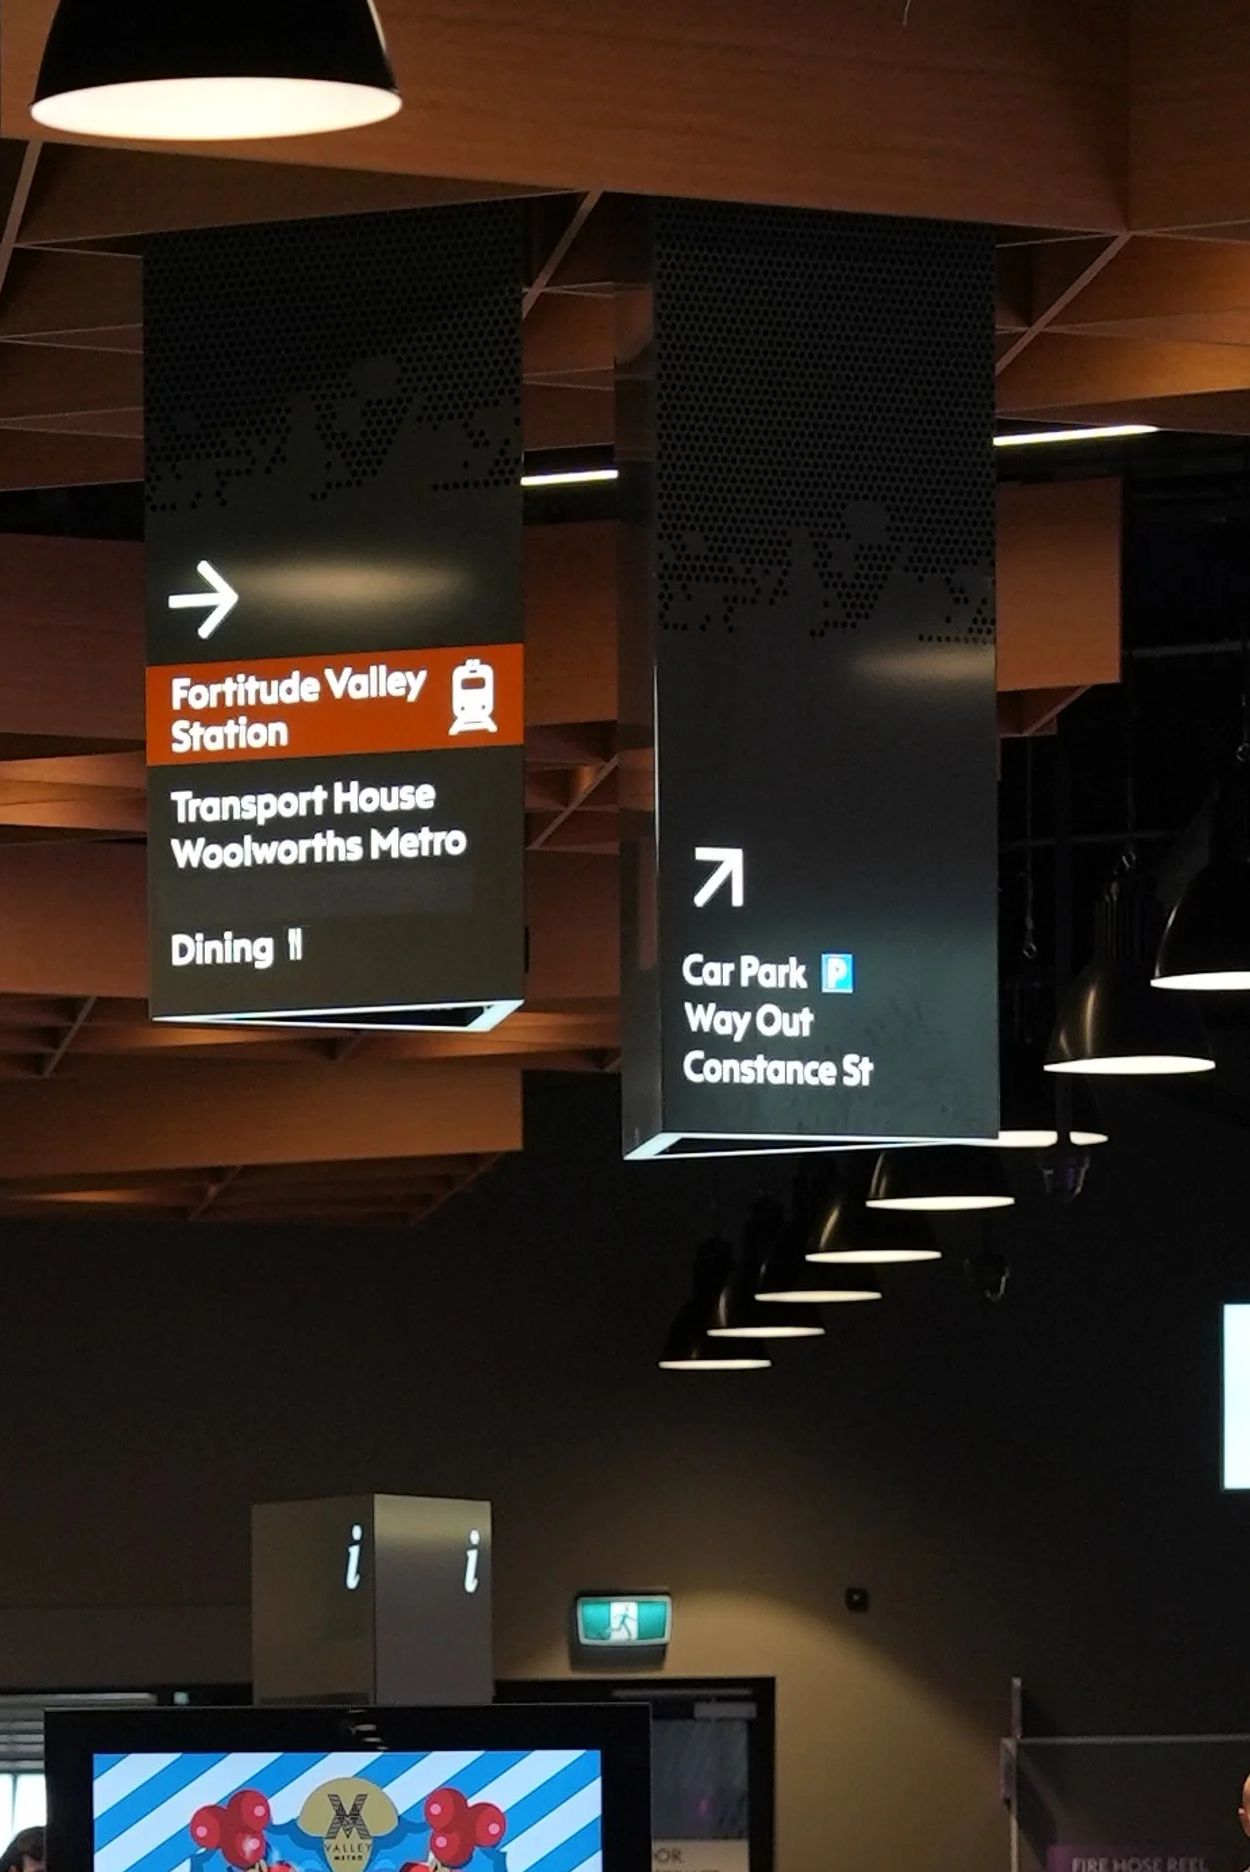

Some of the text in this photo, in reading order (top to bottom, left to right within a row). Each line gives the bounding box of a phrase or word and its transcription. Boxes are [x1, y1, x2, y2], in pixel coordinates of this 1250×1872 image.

[171, 664, 428, 710] Fortitude Valley
[171, 717, 288, 754] Station
[171, 781, 435, 826] Transport House
[171, 827, 467, 869] Woolworths Metro
[171, 929, 274, 969] Dining
[682, 953, 734, 986] Car
[740, 955, 808, 989] Park
[684, 1002, 814, 1042] Way Out
[683, 1051, 874, 1087] Constance St
[323, 1843, 372, 1852] VALLEY
[655, 1848, 683, 1863] OR
[1072, 1858, 1108, 1872] FIRE
